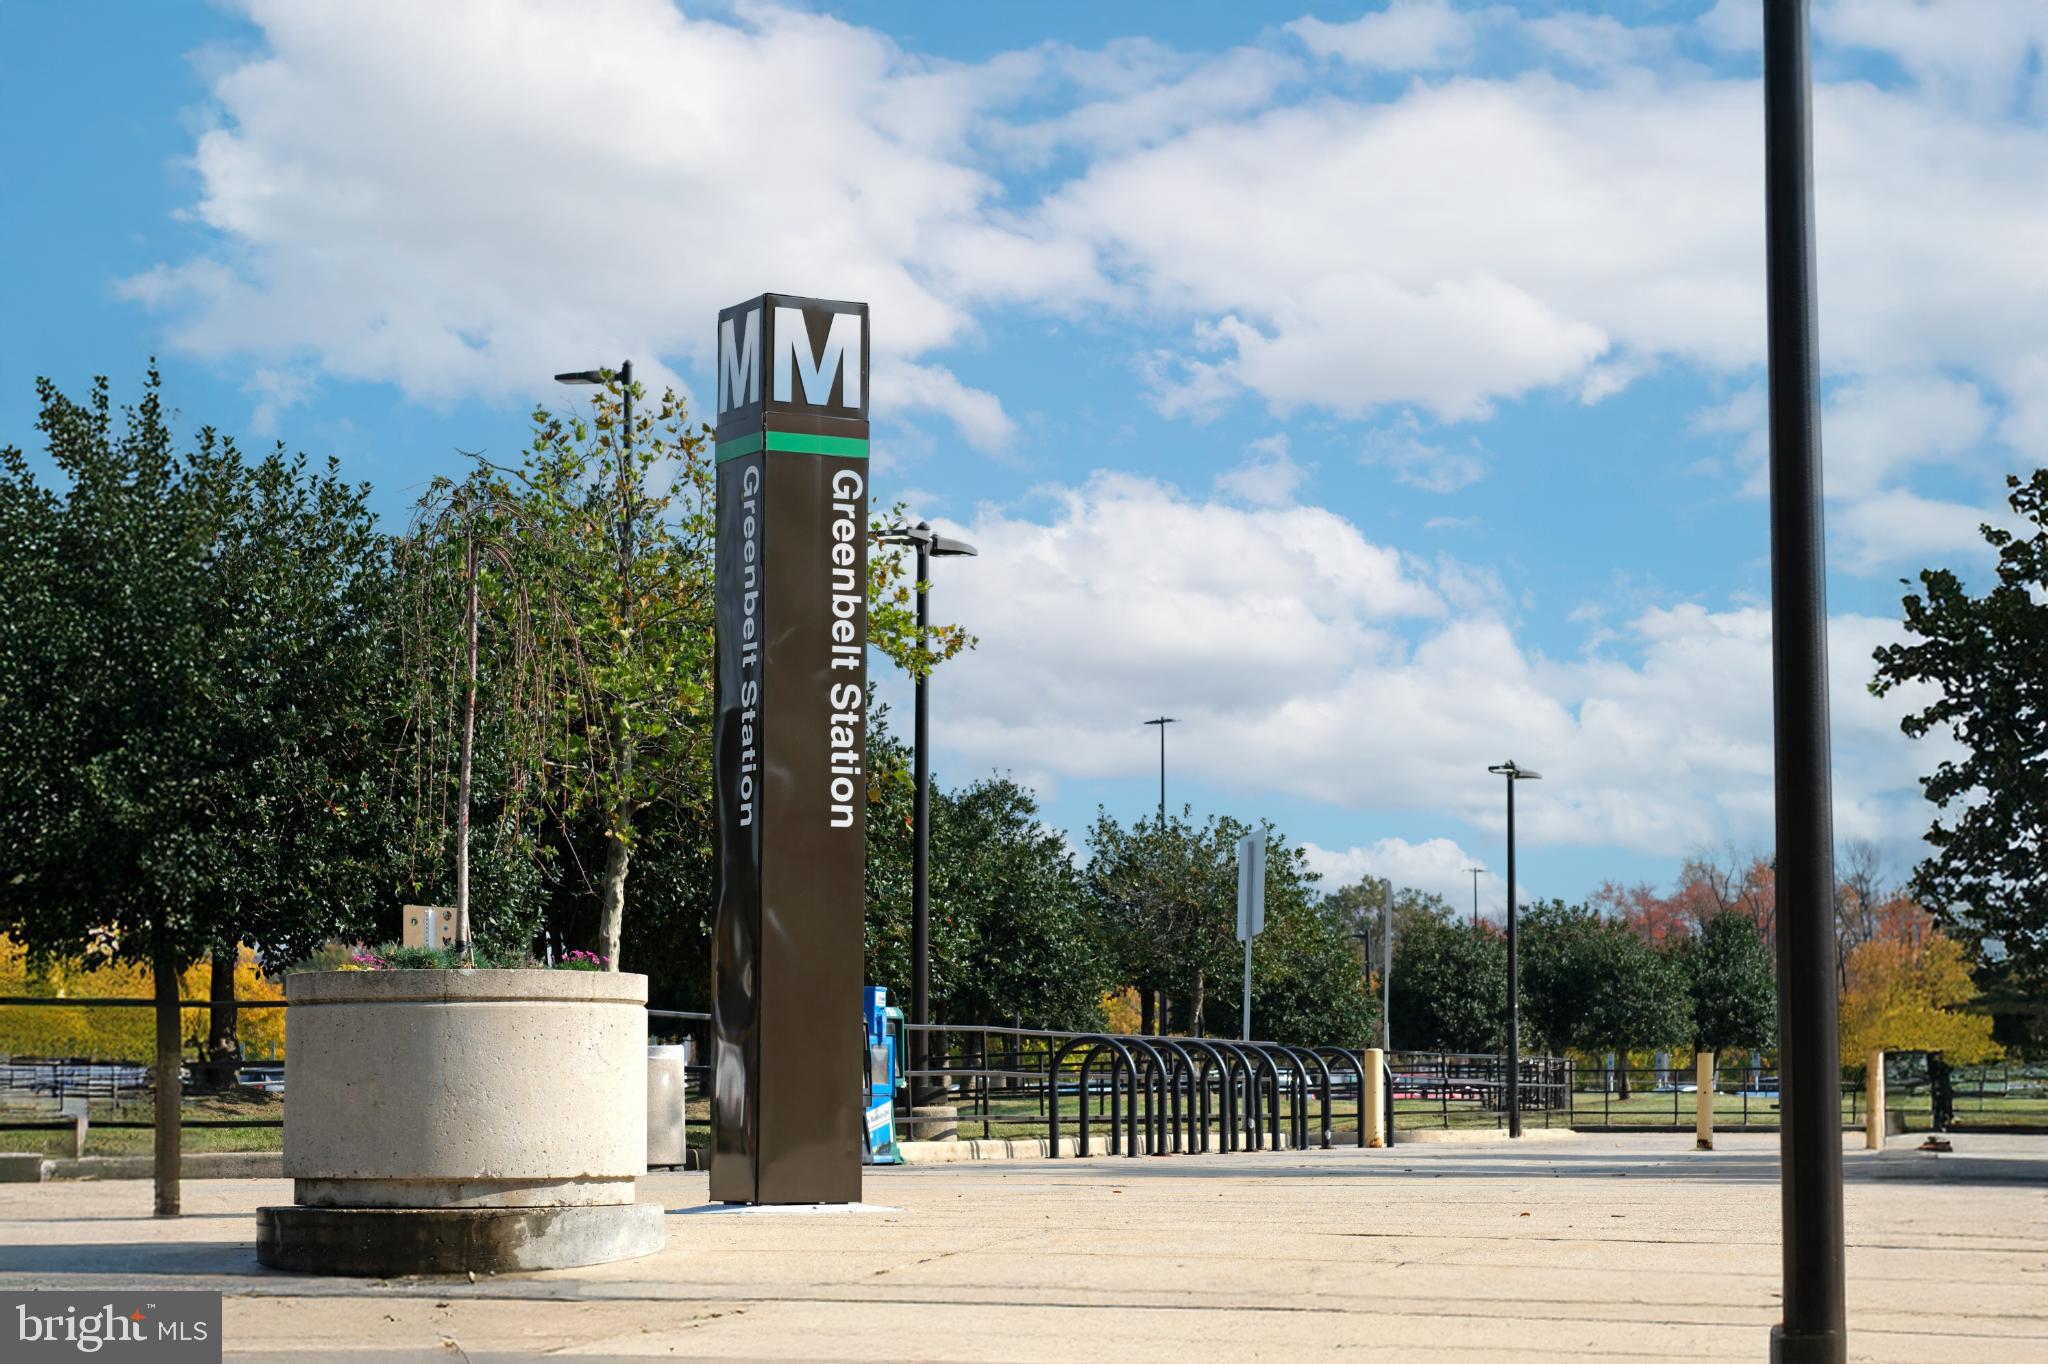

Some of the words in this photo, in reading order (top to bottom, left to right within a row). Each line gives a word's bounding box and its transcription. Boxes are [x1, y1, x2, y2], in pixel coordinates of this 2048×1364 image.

[719, 307, 761, 415] M
[773, 306, 862, 409] M
[742, 465, 760, 669] Greenbelt
[831, 469, 864, 671] Greenbelt
[740, 680, 758, 828] Station
[830, 683, 862, 828] Station
